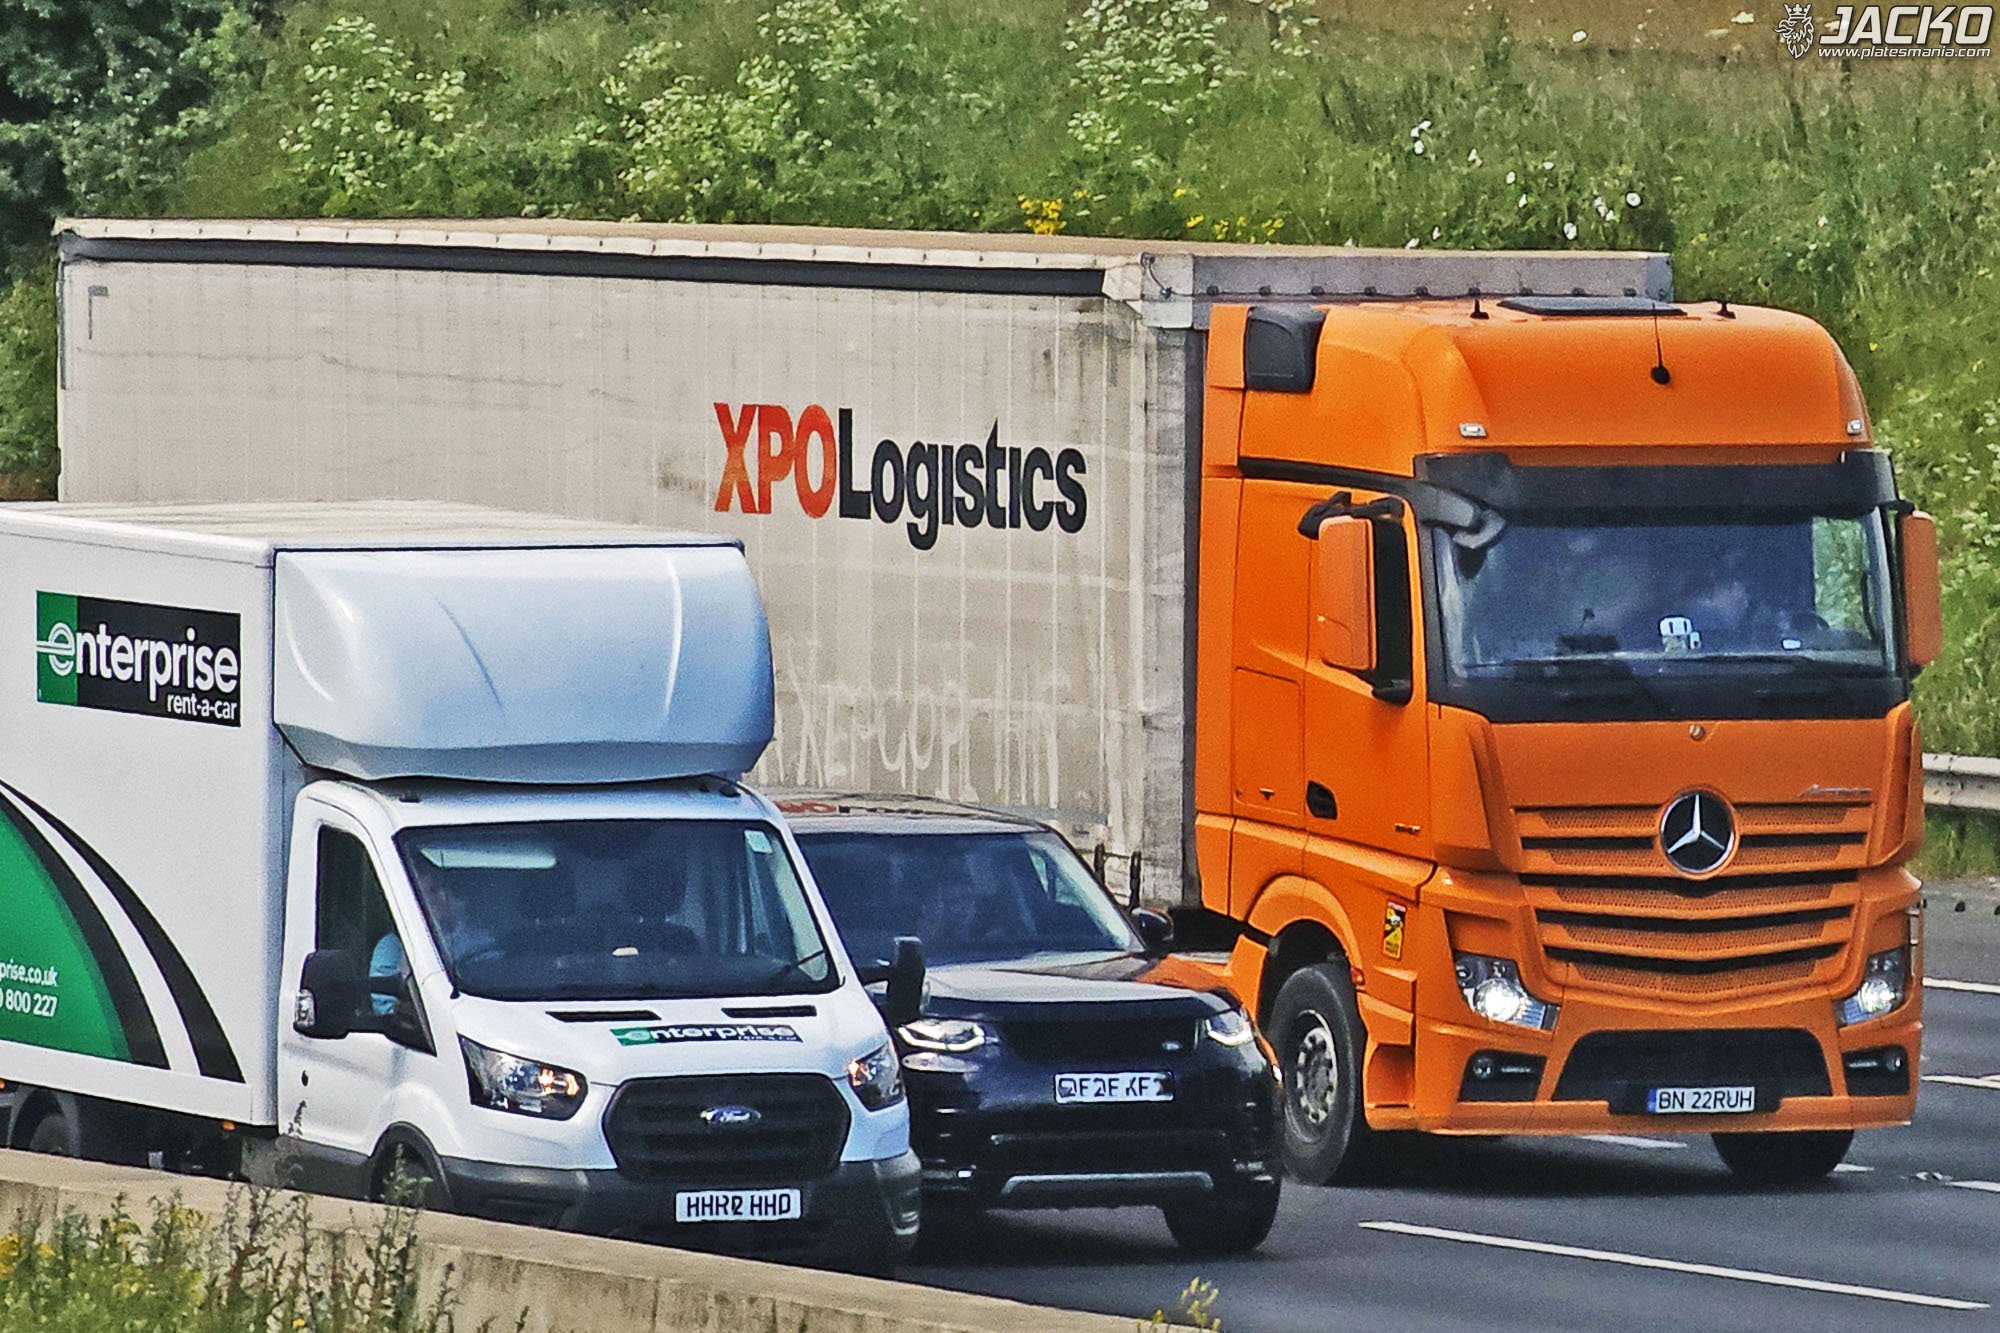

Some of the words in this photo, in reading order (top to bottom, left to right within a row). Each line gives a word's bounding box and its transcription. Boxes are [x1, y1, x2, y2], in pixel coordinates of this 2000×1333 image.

[714, 402, 837, 519] XPO
[839, 408, 1087, 551] Logistics
[36, 622, 239, 702] enterprise
[167, 693, 238, 721] rent-a-car
[5, 988, 31, 1014] 800
[33, 992, 58, 1017] 227
[1658, 1090, 1685, 1110] BN
[1691, 1089, 1753, 1110] 22RUH
